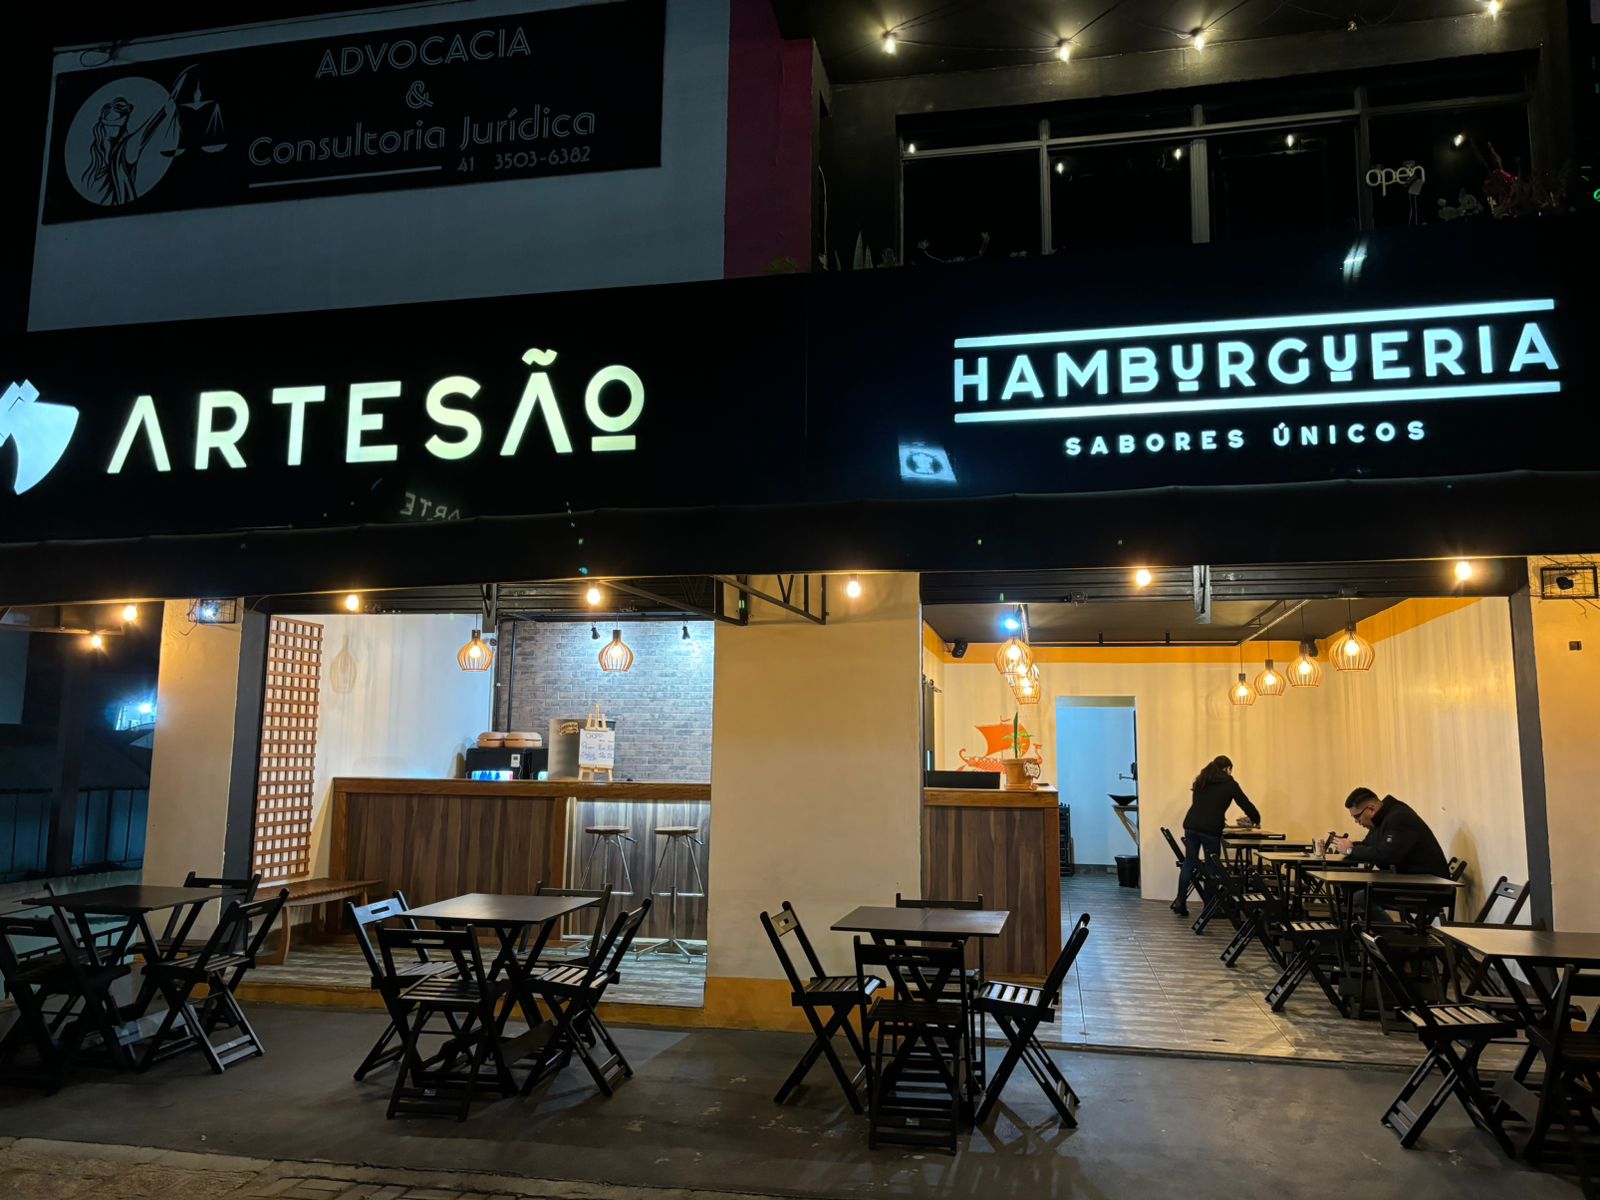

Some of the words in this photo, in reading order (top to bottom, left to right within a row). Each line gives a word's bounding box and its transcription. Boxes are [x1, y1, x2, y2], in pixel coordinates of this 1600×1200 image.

[315, 26, 531, 79] ADVOCACIA
[405, 80, 434, 109] &
[248, 119, 446, 166] Consultoria
[459, 103, 595, 151] Jurídica
[457, 156, 474, 172] 41
[494, 145, 591, 170] 3503-6382
[1365, 164, 1426, 197] open
[954, 322, 1560, 403] HAMBURGUERIA
[106, 347, 645, 474] ARTESÃO
[1065, 429, 1244, 456] SABORES
[1273, 420, 1425, 447] ÚNICOS
